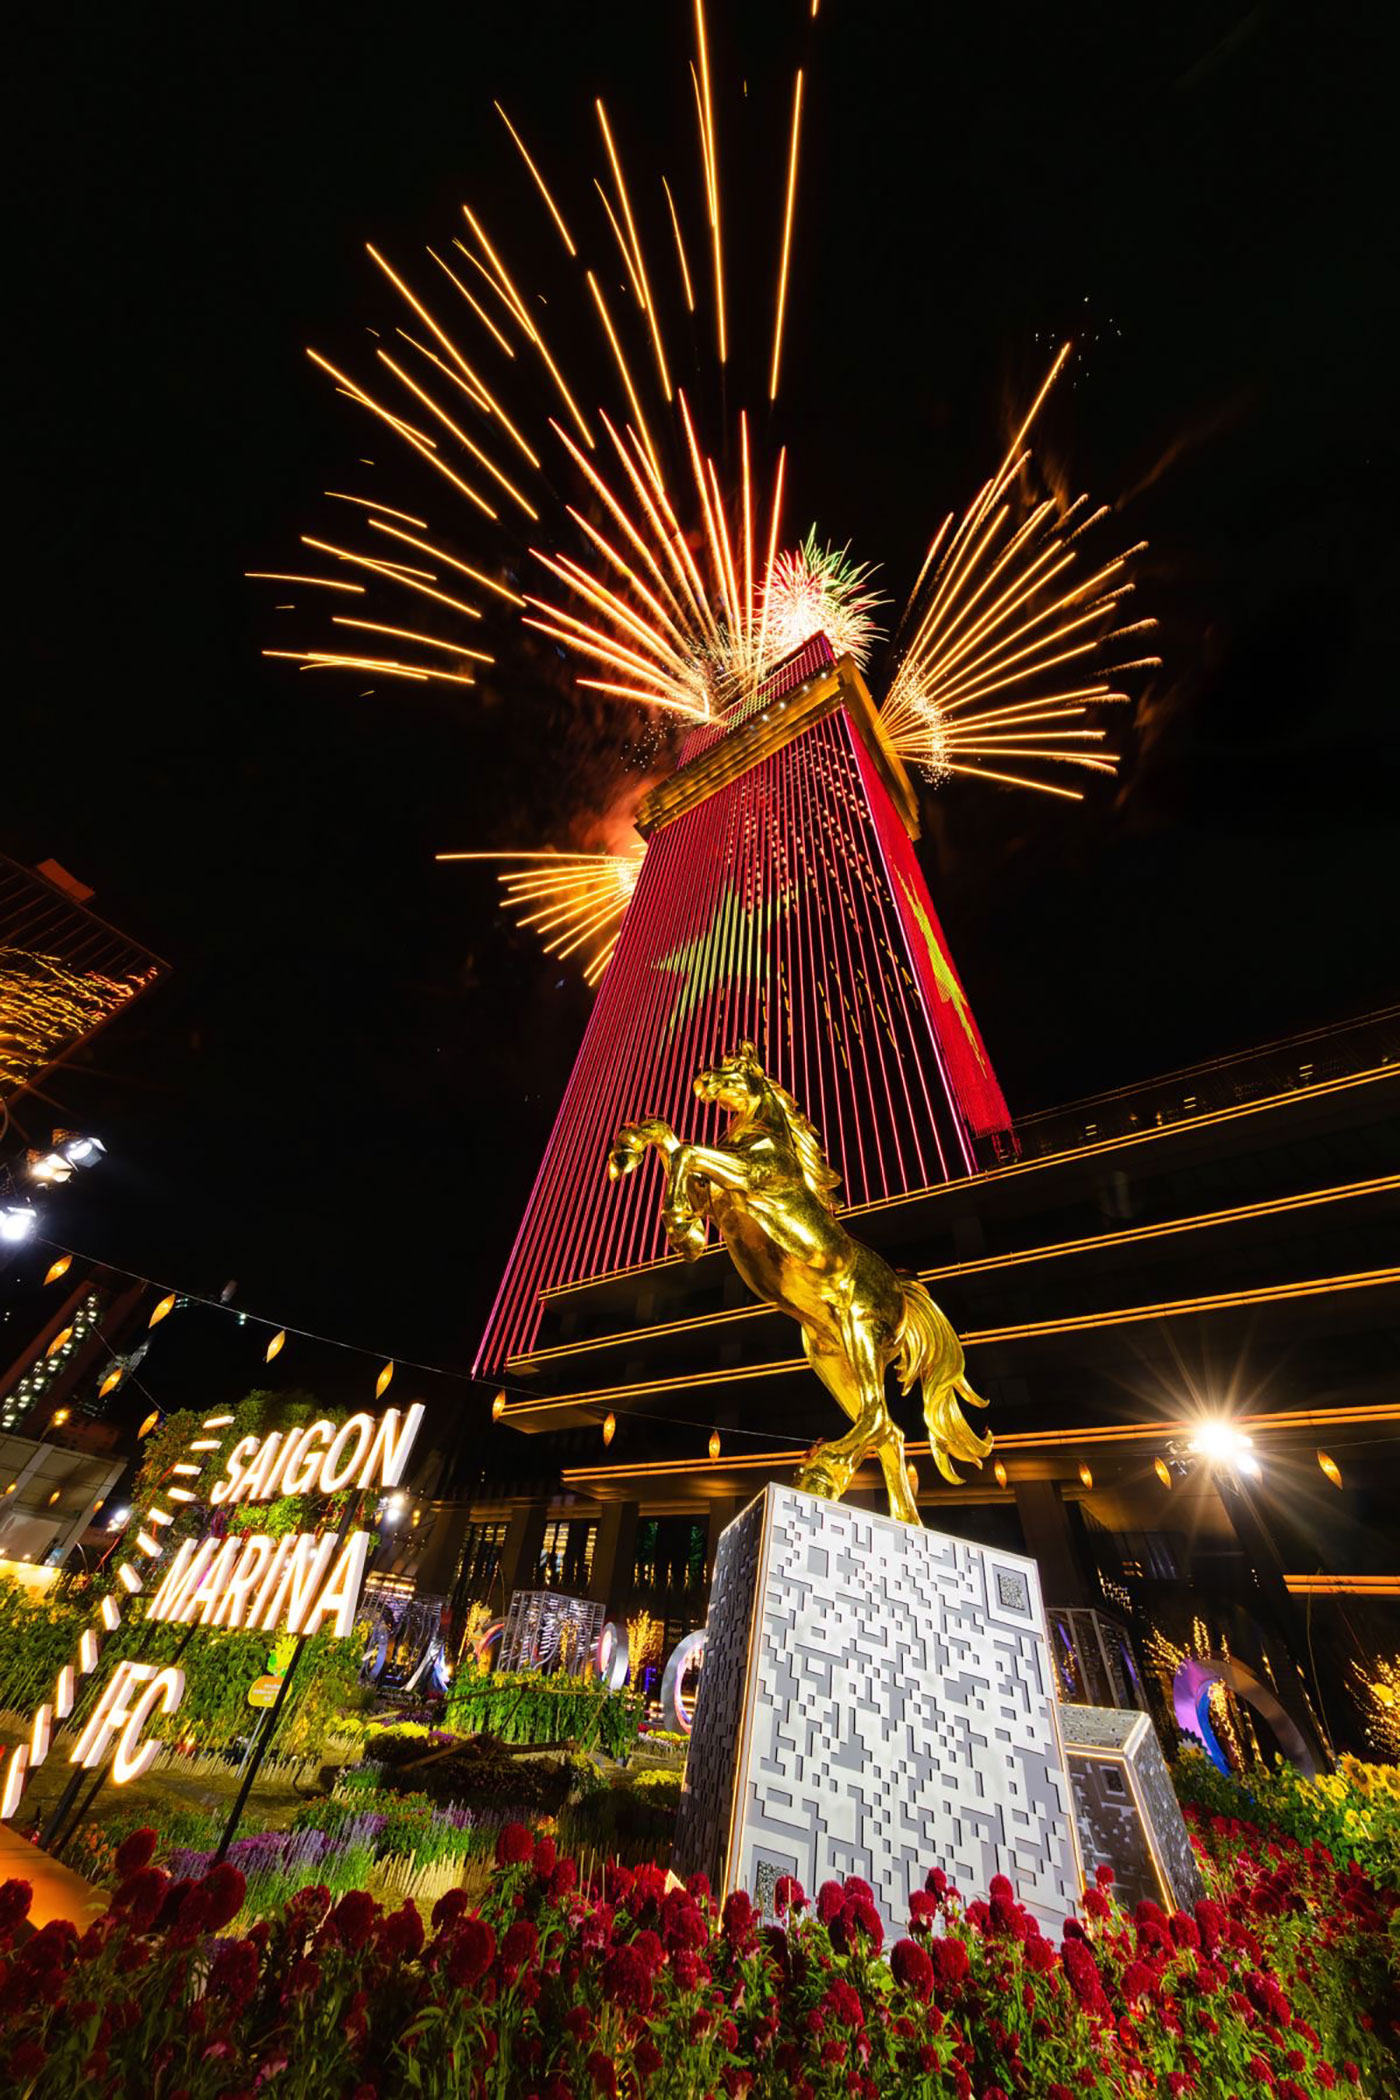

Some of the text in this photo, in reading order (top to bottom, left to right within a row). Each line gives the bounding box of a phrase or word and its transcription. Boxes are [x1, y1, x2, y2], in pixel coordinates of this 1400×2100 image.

[210, 1403, 425, 1504] SAIGON
[147, 1531, 370, 1637] MARINA
[69, 1661, 185, 1783] IFC
